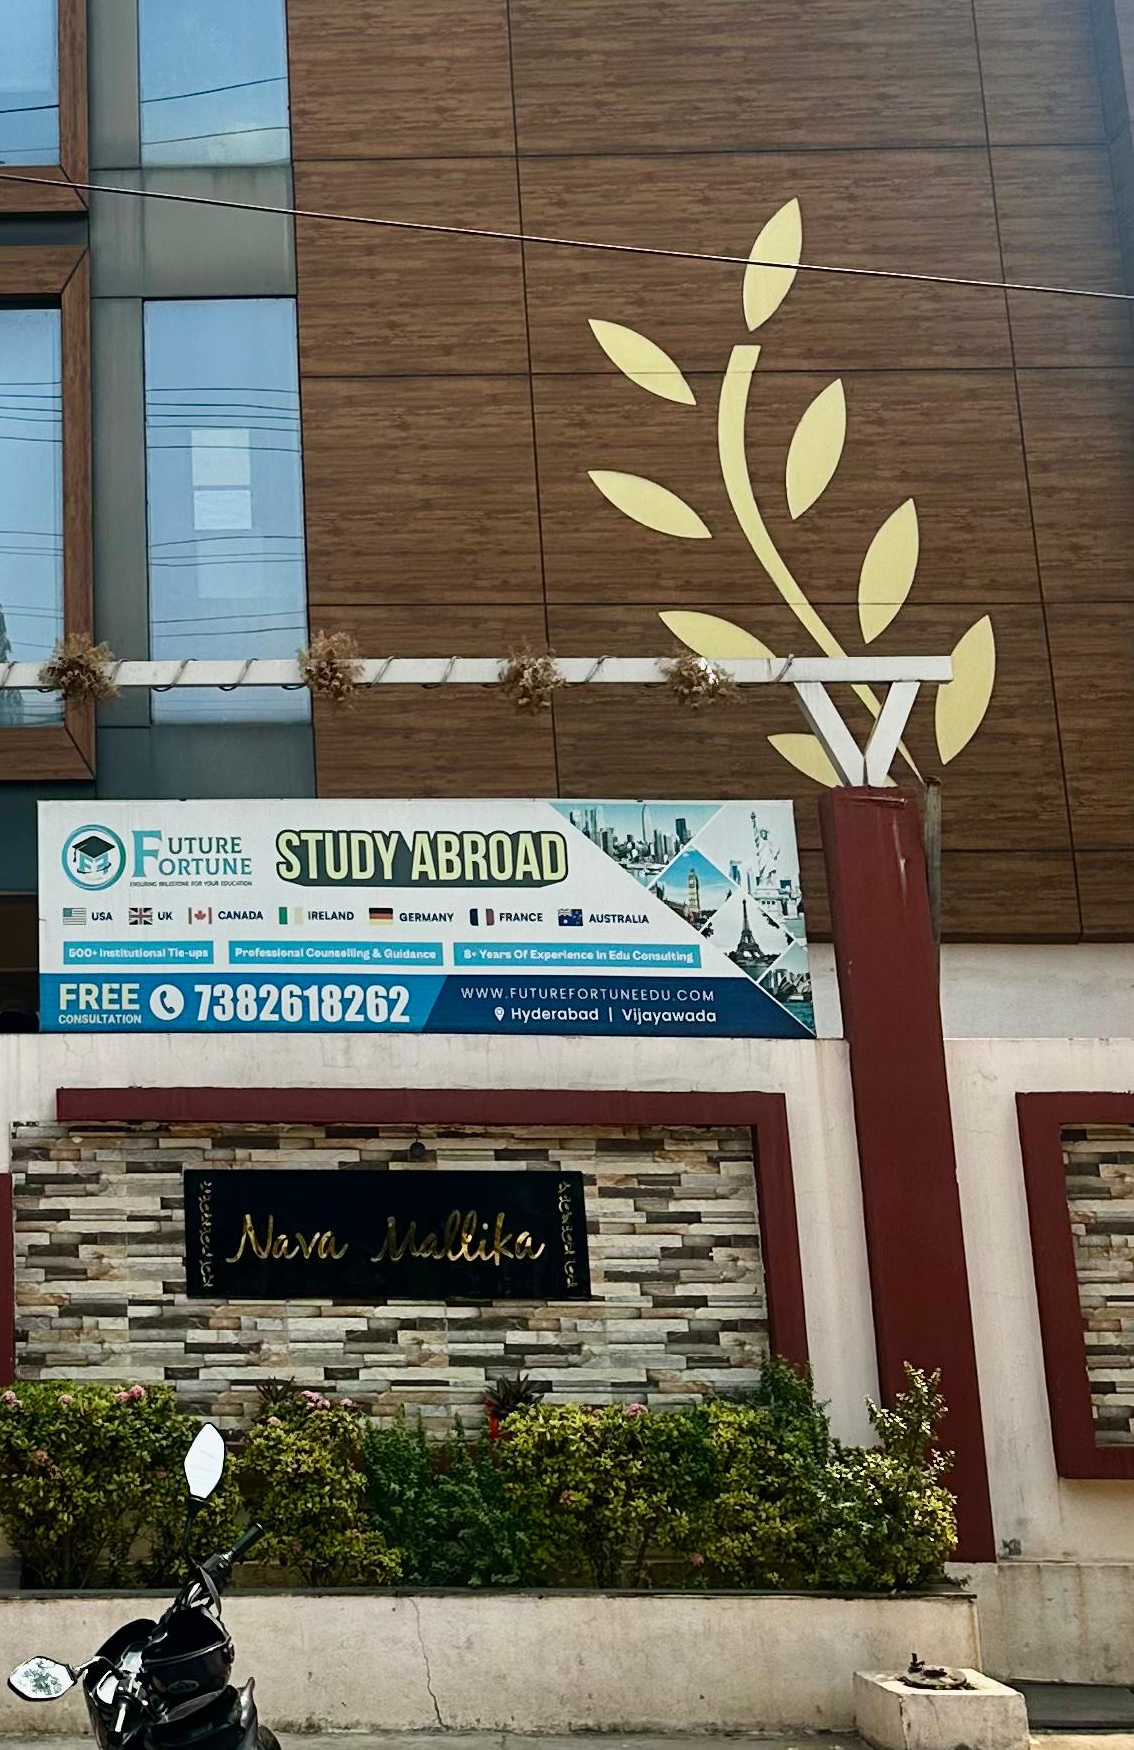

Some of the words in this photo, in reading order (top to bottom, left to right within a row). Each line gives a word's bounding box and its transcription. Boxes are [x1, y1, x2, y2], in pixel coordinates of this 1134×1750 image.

[277, 832, 401, 881] STUDY
[411, 833, 567, 882] ABROAD
[91, 912, 113, 921] USA
[157, 911, 173, 921] UK
[218, 910, 263, 920] CANADA
[307, 910, 354, 921] IRELAND
[399, 912, 454, 922] GERMANY
[499, 912, 543, 922] FRANCE
[589, 913, 649, 924] AUSTRALIA
[69, 948, 97, 959] 500+
[99, 947, 166, 959] Institutional
[169, 948, 209, 960] Tie-ups
[235, 947, 304, 958] Professional
[306, 947, 370, 960] Counselling
[373, 949, 382, 959] &
[384, 948, 436, 960] Guidance
[479, 950, 512, 960] Years
[515, 950, 529, 960] Of
[530, 950, 594, 962] Experience
[596, 951, 607, 961] In
[609, 951, 631, 961] Edu
[633, 951, 694, 963] Consulting
[59, 983, 140, 1011] FREE
[461, 987, 715, 1002] WWW.FUTUREFORTUNEEDU.COM
[194, 984, 411, 1023] 7382618262
[58, 1014, 142, 1024] CONSULTATION
[511, 1007, 599, 1023] Hyderabad
[621, 1008, 717, 1027] Vijayawada
[226, 1213, 349, 1264] Nava
[370, 1209, 545, 1267] Mallika
